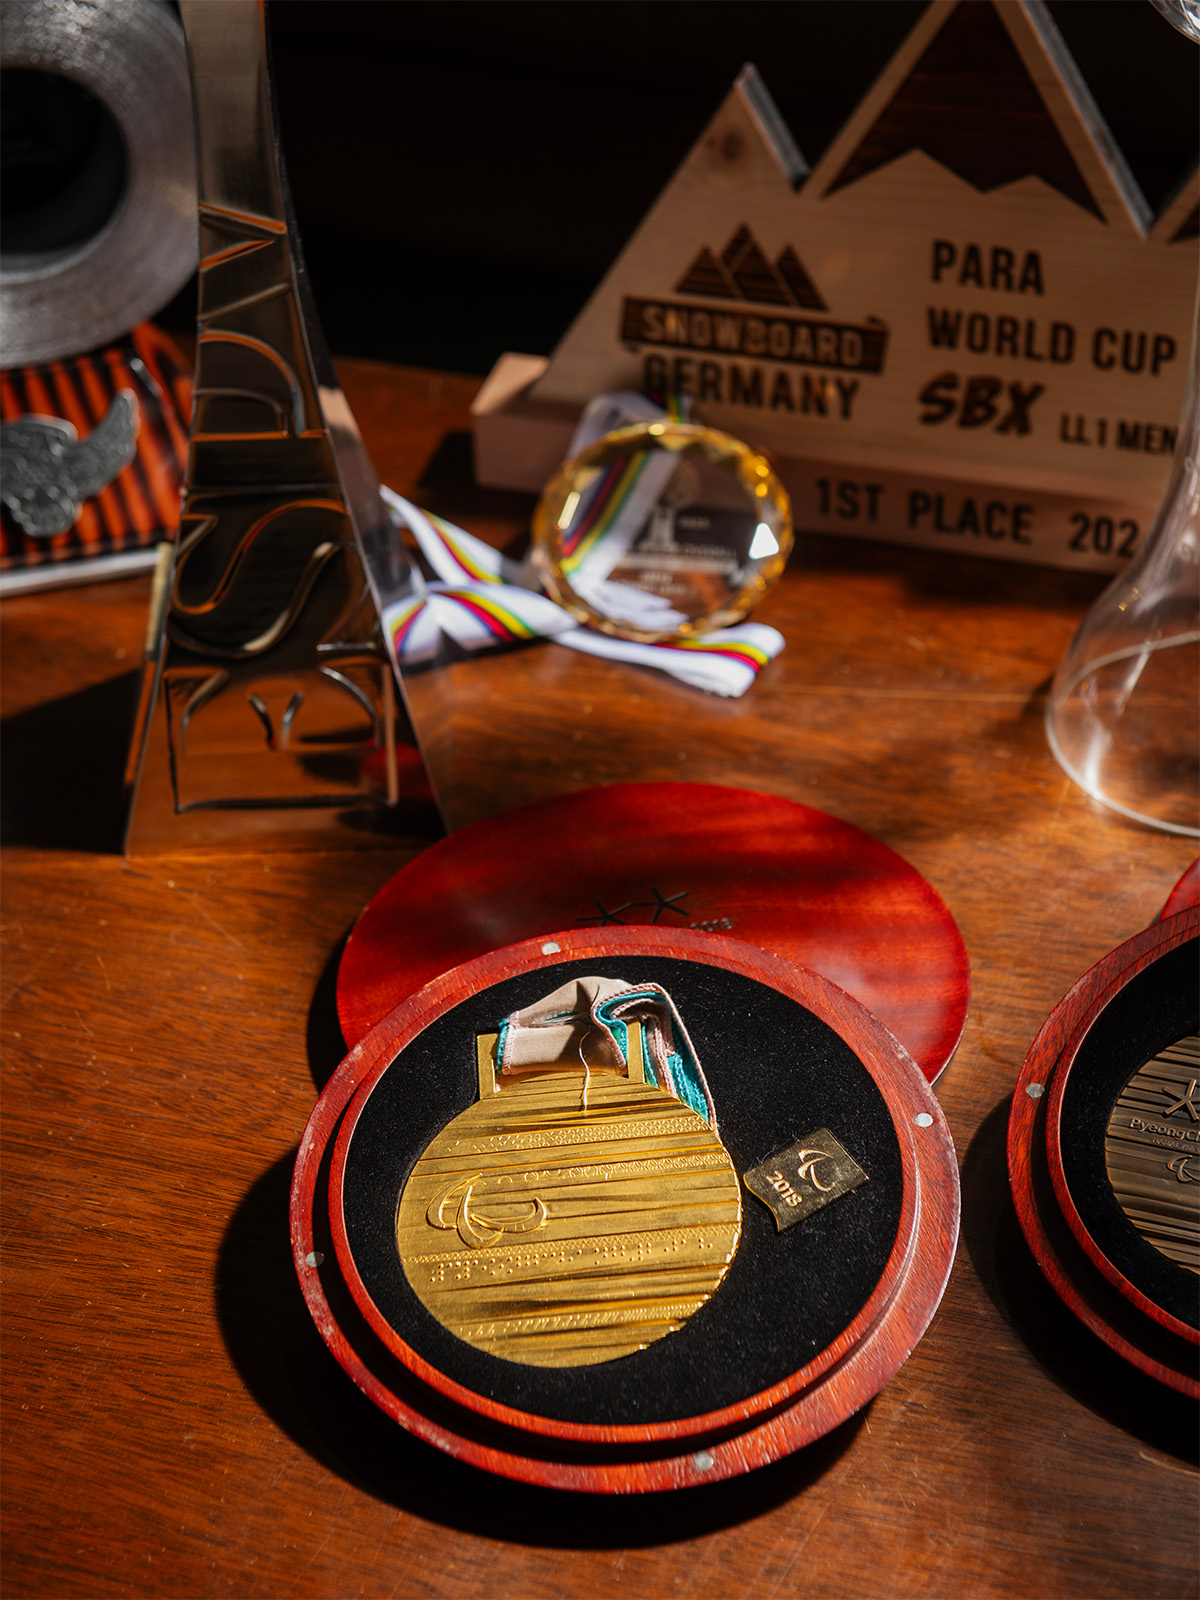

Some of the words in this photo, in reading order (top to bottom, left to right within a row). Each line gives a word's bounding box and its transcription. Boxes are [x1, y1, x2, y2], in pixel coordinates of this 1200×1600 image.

[930, 239, 1045, 296] PARA
[643, 305, 863, 367] SNOWBOARD
[925, 307, 1076, 365] WORLD
[1092, 327, 1177, 377] CUP
[644, 355, 858, 419] GERMANY
[917, 372, 1045, 436] SBX
[1115, 419, 1177, 456] MEN
[815, 477, 886, 523] 1ST
[907, 490, 1033, 545] PLACE
[766, 1170, 803, 1207] 2018
